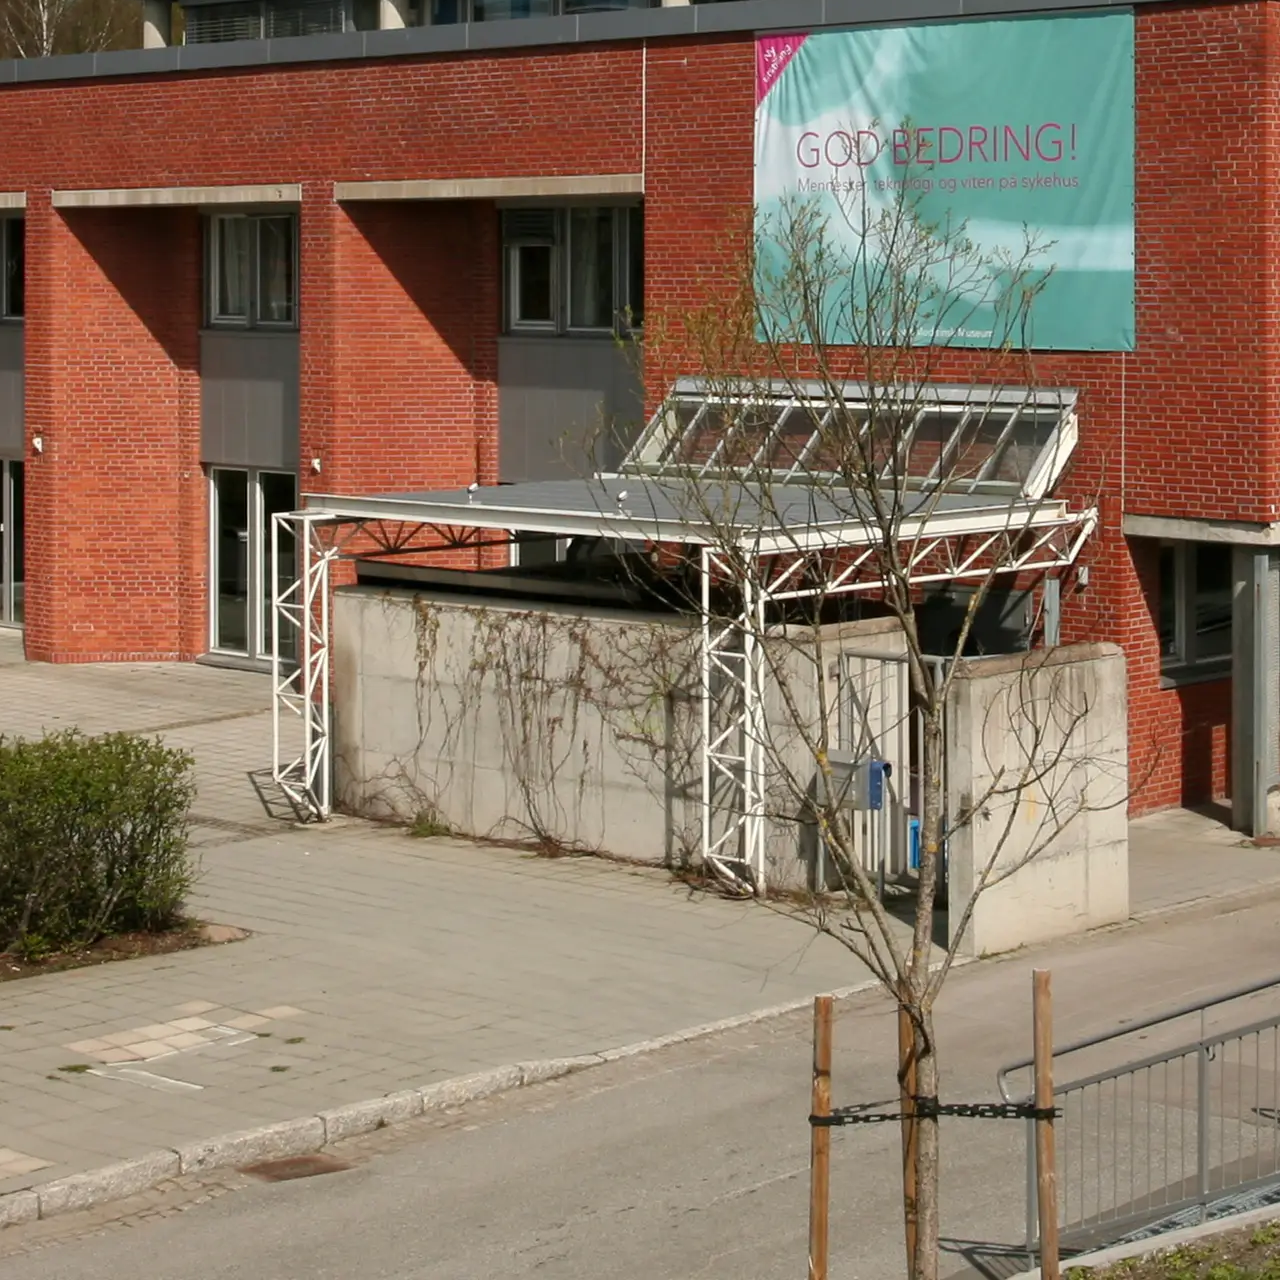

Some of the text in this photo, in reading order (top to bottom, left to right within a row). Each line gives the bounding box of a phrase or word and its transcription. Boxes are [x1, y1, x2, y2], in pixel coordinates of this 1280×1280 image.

[796, 122, 1076, 168] GOD BEDRING!
[938, 178, 957, 193] og
[961, 175, 995, 189] viten
[999, 174, 1018, 191] på
[1021, 172, 1079, 192] sykehus
